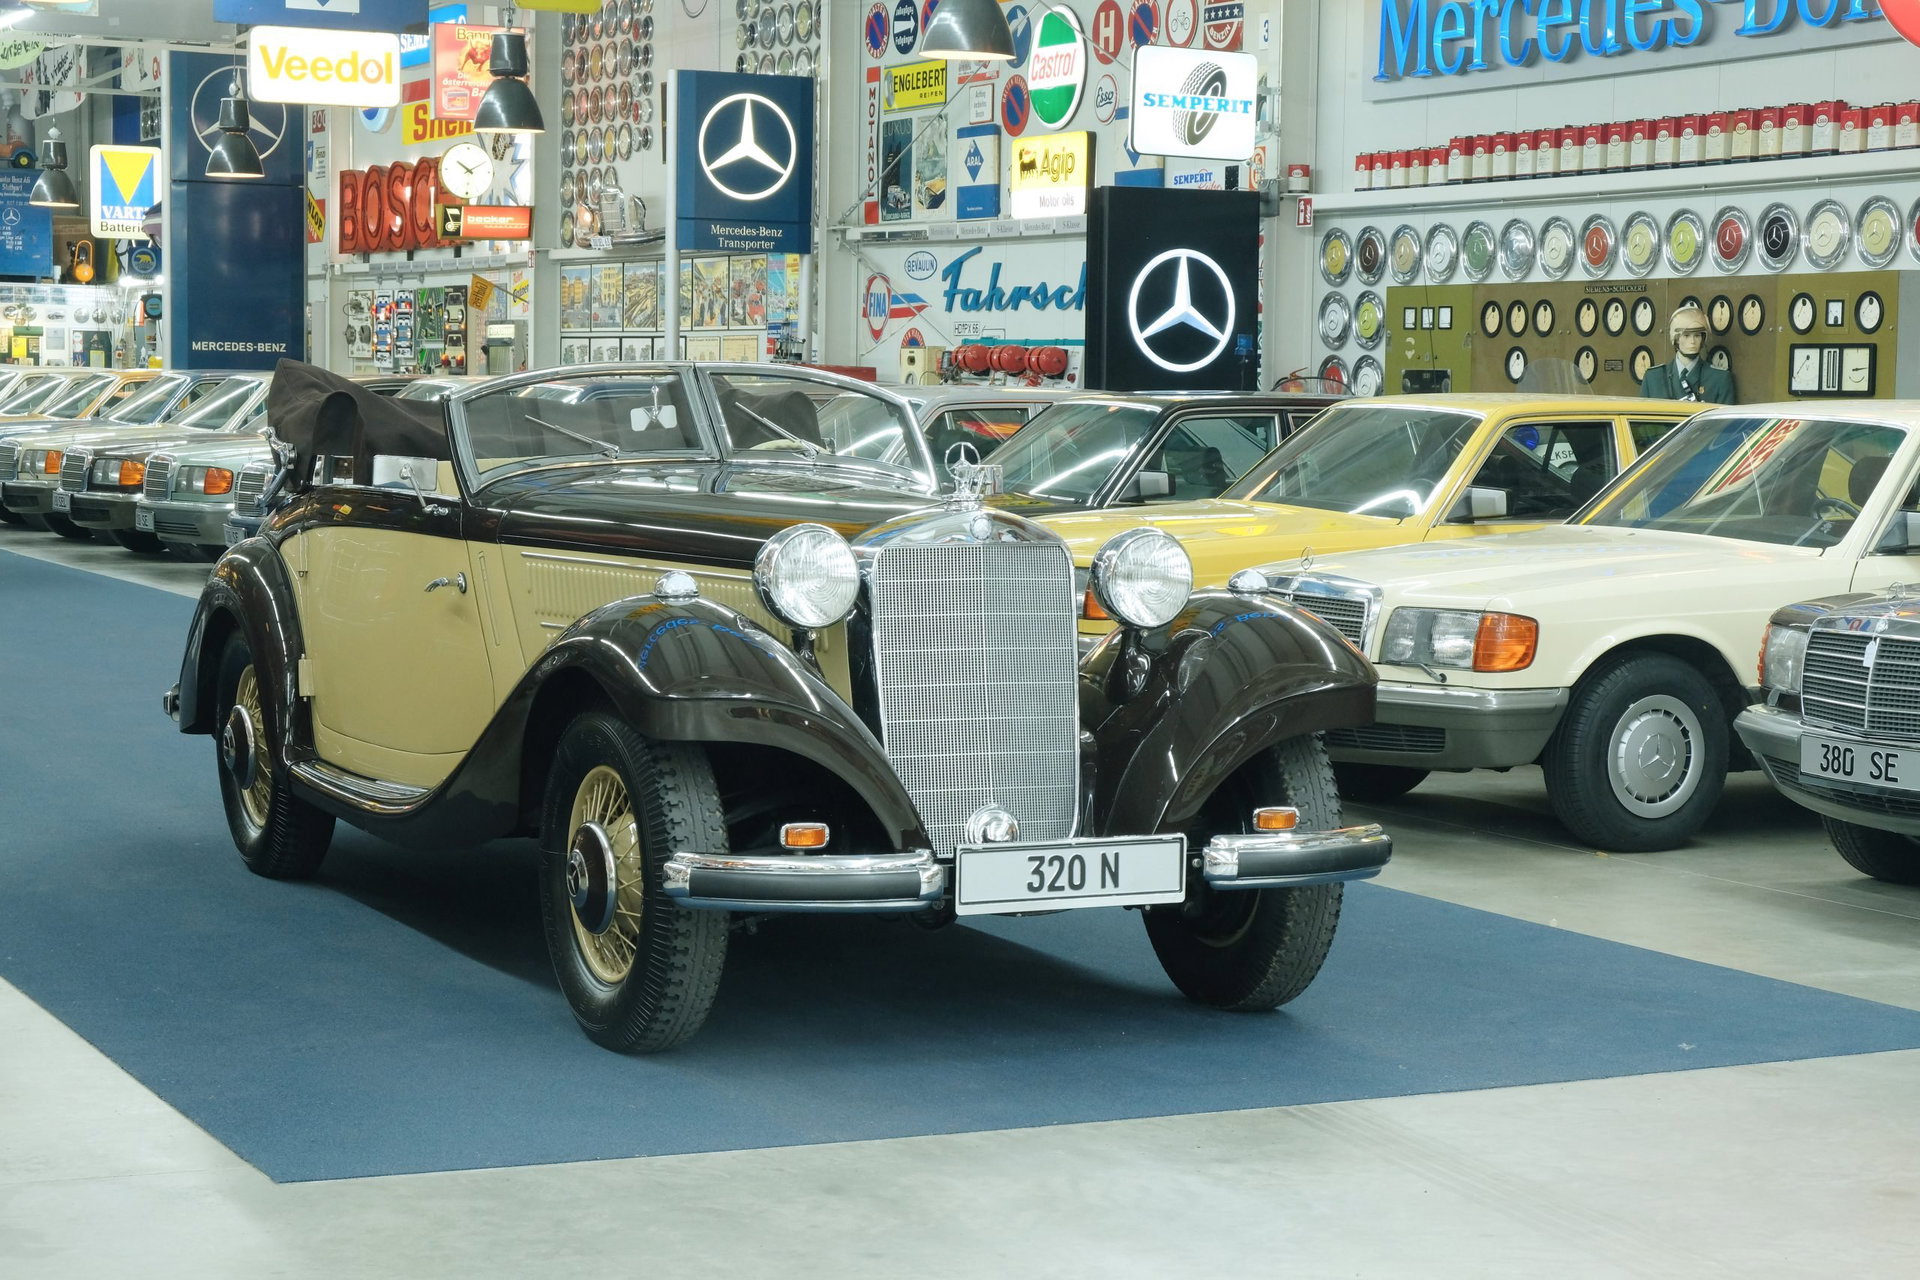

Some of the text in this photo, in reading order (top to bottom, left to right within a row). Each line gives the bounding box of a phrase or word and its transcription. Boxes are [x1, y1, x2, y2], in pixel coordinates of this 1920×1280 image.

[1100, 9, 1115, 54] H
[1209, 24, 1231, 40] BENZIN
[1263, 19, 1269, 42] 3
[259, 45, 392, 84] Veedol
[1031, 49, 1077, 81] Castrol
[893, 67, 946, 93] ENGLEBERT
[919, 90, 943, 99] REIFEN
[1096, 87, 1114, 106] Esso
[1143, 92, 1253, 114] SEMPERIT
[883, 119, 912, 137] LUXUS
[867, 87, 876, 197] MOTANOL
[966, 156, 982, 167] ARAL
[1040, 146, 1076, 182] Agip
[1173, 172, 1213, 185] SEMPERIT
[1039, 194, 1074, 208] Motor oils
[101, 206, 147, 219] VART
[308, 198, 322, 231] NLOP
[467, 215, 514, 224] becker
[711, 224, 783, 237] Mercedes-Benz
[718, 237, 775, 249] Transporter
[1586, 285, 1646, 293] SIEMENS-SCHUCKERT
[868, 291, 887, 317] FINA
[192, 341, 287, 352] MERCEDES-BENZ
[1820, 743, 1899, 783] 380 SE
[1027, 852, 1119, 893] 320 N
